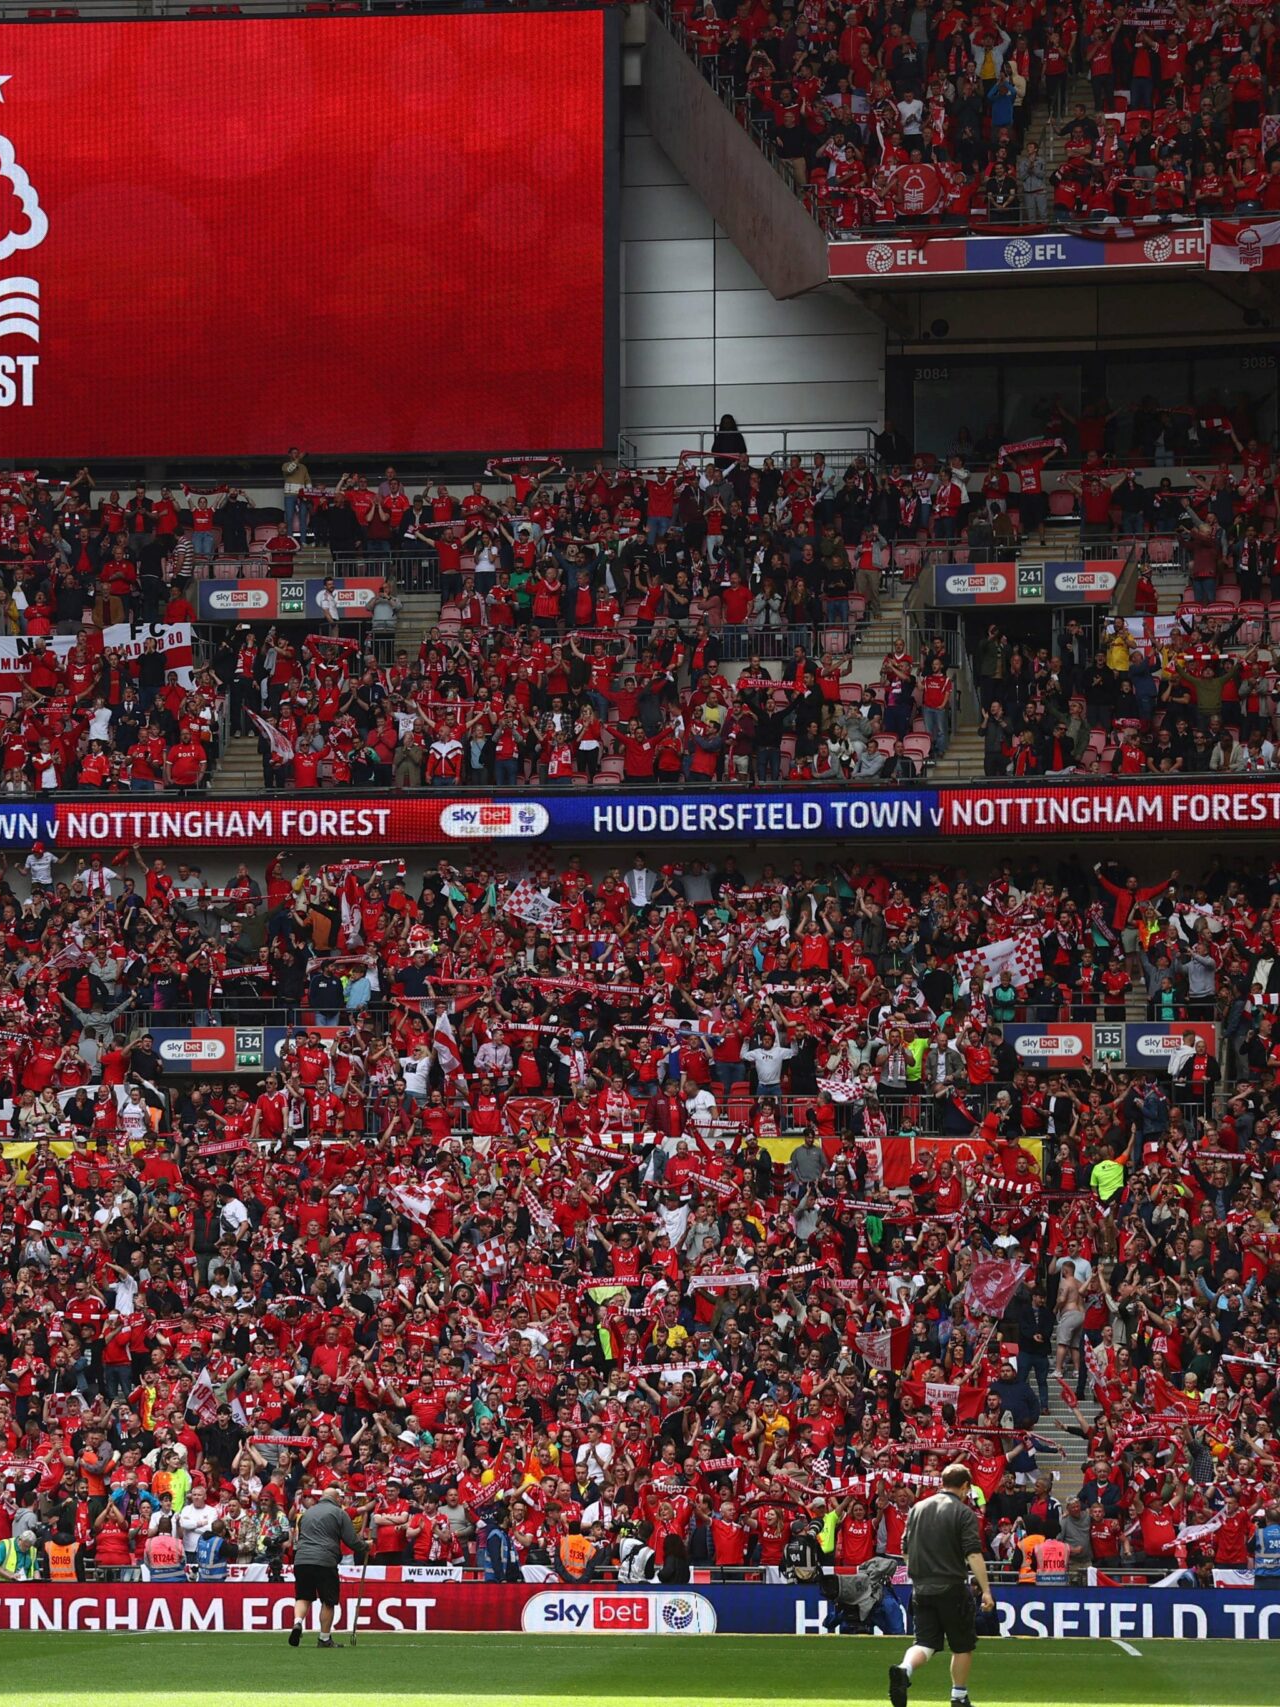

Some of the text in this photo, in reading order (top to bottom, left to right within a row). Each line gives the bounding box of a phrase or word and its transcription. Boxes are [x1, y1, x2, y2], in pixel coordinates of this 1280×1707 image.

[896, 249, 928, 266] EFL
[1034, 245, 1066, 261] EFL
[914, 369, 949, 380] 3084
[953, 578, 985, 588] sky bet
[1020, 571, 1042, 585] 241
[1062, 574, 1094, 586] sky bet
[282, 587, 303, 598] 240
[338, 591, 355, 600] bet
[216, 593, 248, 604] sky bet
[115, 631, 183, 656] MADD 80
[452, 807, 510, 824] sky bet
[594, 793, 1280, 832] HUDDERSFIELD TOWN v NOTTINGHAM FOREST
[46, 820, 60, 840] v
[68, 810, 272, 840] NOTTINGHAM
[282, 809, 390, 837] FOREST
[520, 825, 534, 833] EFL
[237, 1037, 261, 1048] 134
[1022, 1038, 1058, 1048] sky bet
[1096, 1032, 1120, 1044] 135
[1144, 1038, 1181, 1047] sky bet
[167, 1042, 201, 1052] sky bet
[408, 1568, 454, 1576] WE WANT
[242, 1598, 436, 1631] FOREST
[544, 1600, 642, 1626] sky bet
